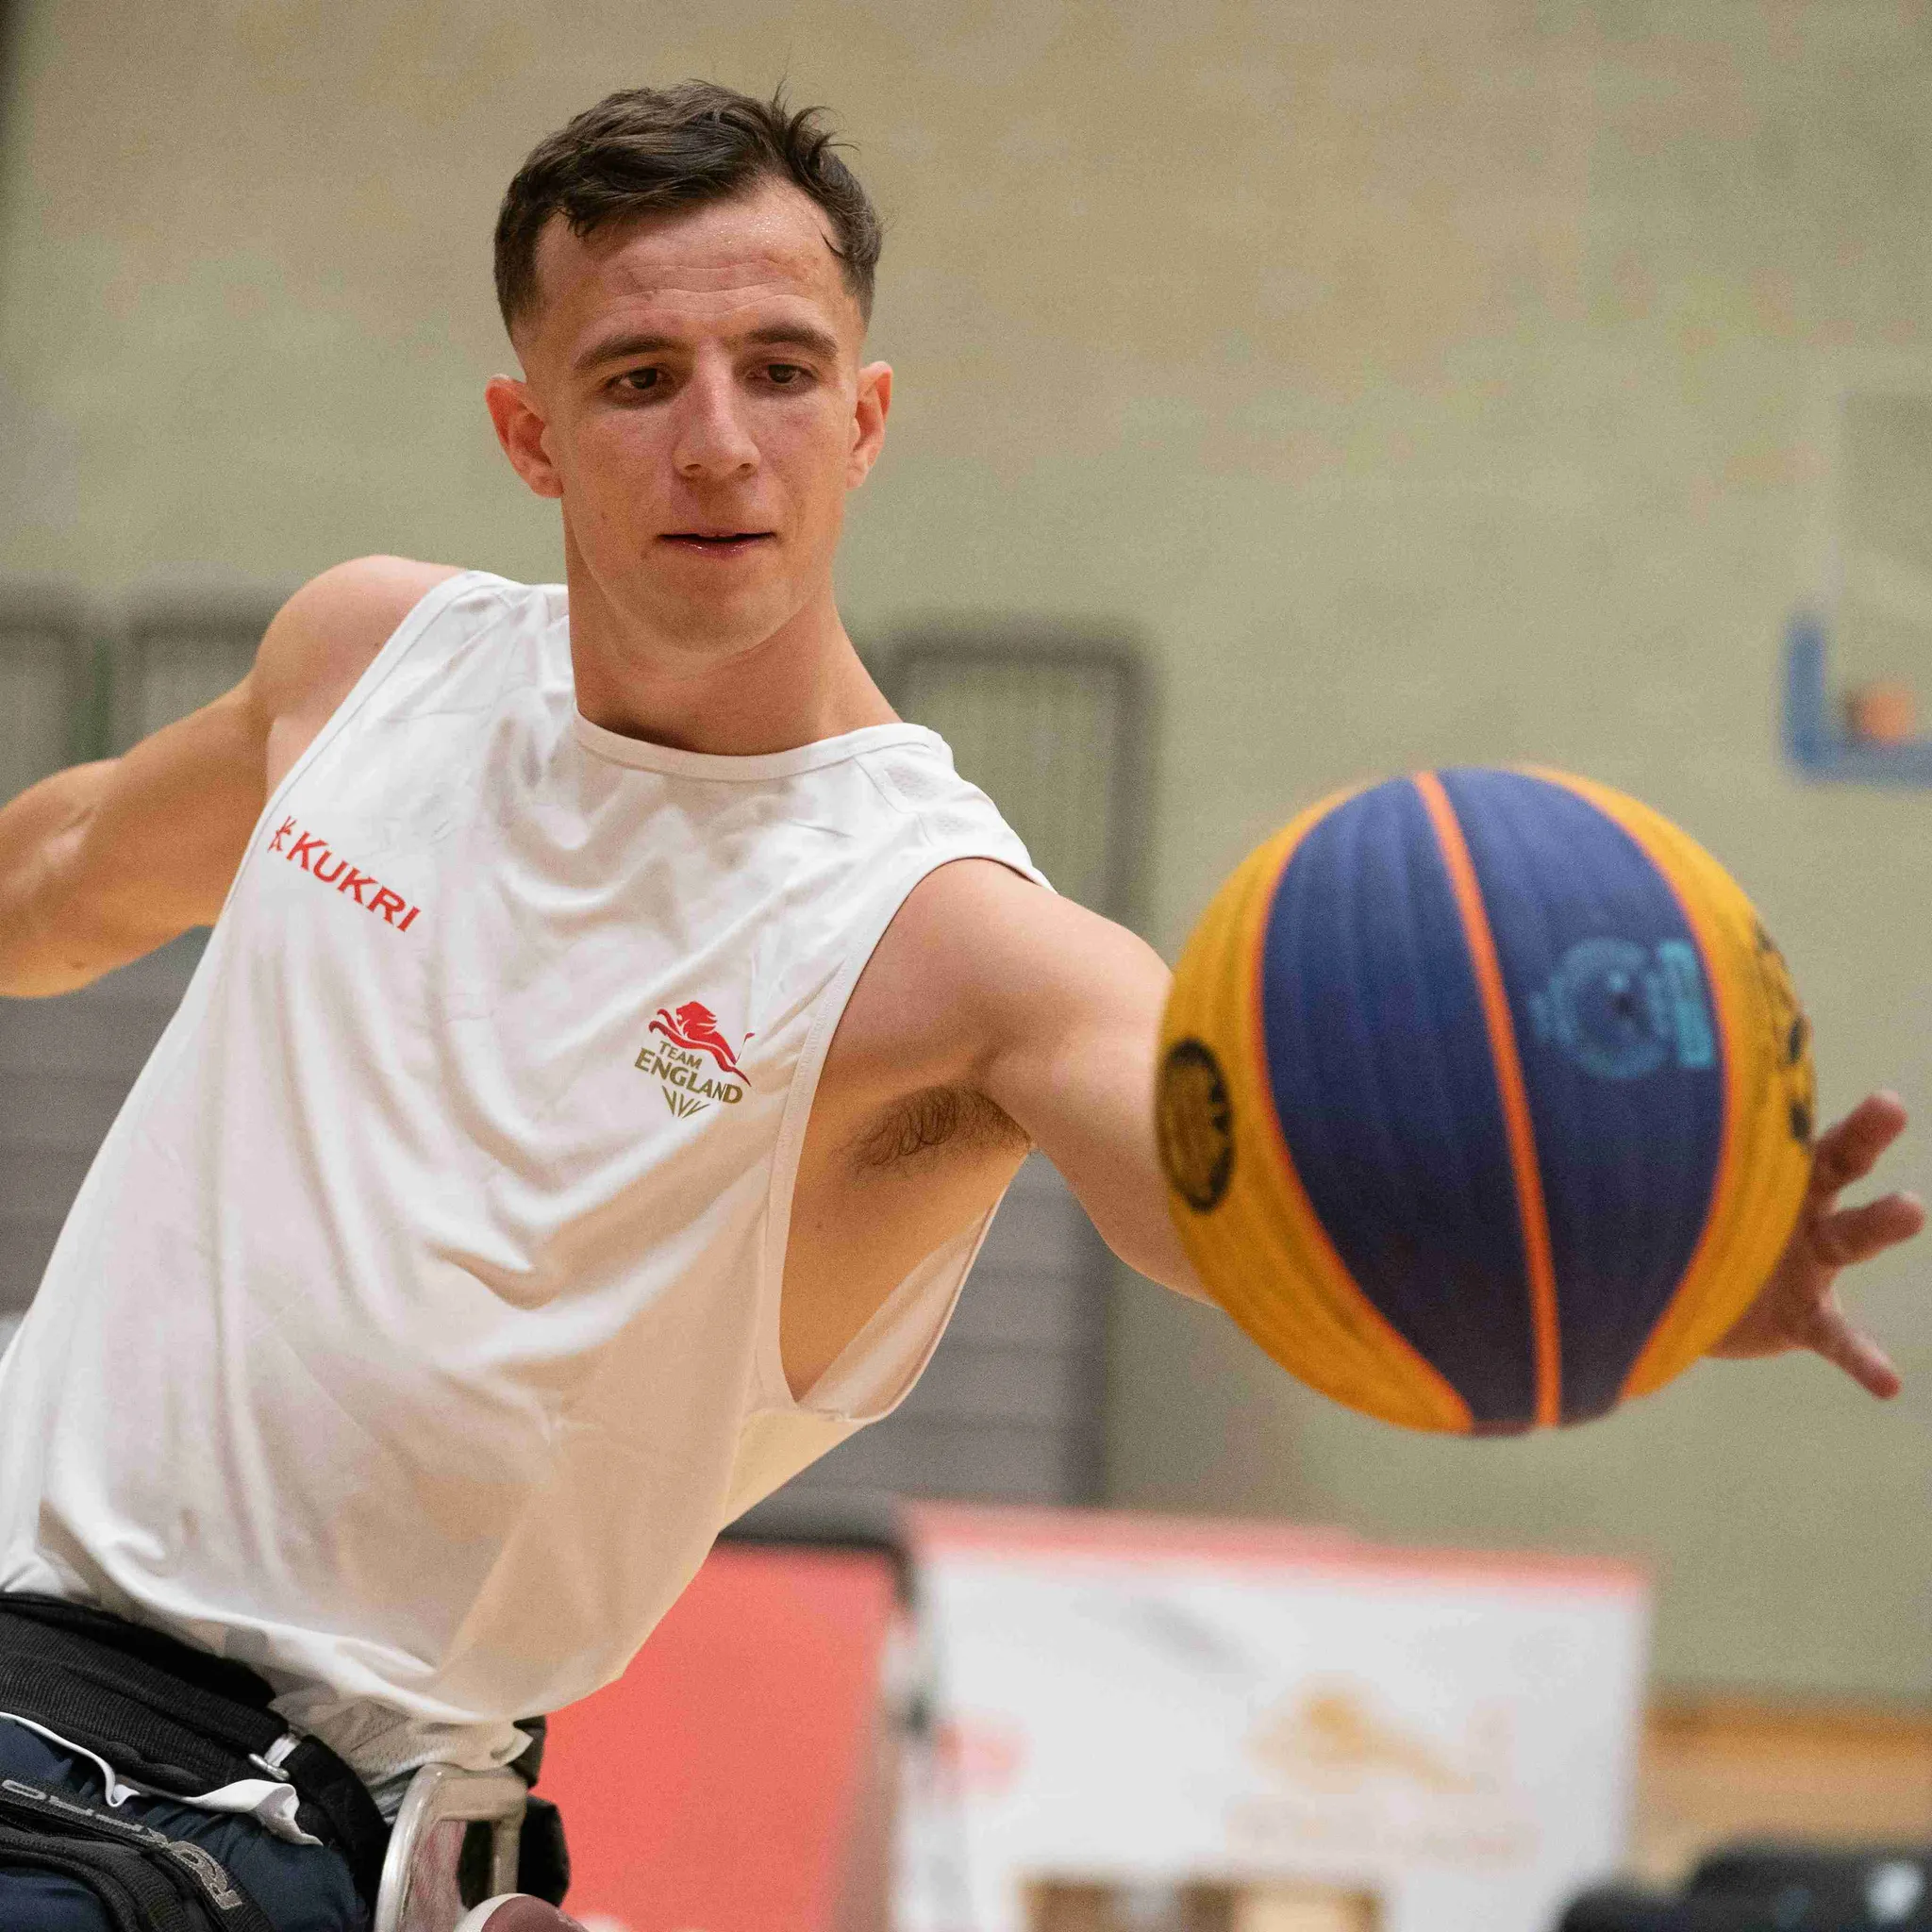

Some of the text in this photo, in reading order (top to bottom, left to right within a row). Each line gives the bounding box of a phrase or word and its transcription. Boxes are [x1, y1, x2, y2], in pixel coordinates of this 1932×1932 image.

[286, 830, 422, 932] KUKRI
[634, 1047, 743, 1105] ENGLAND
[660, 1041, 703, 1071] TEAM
